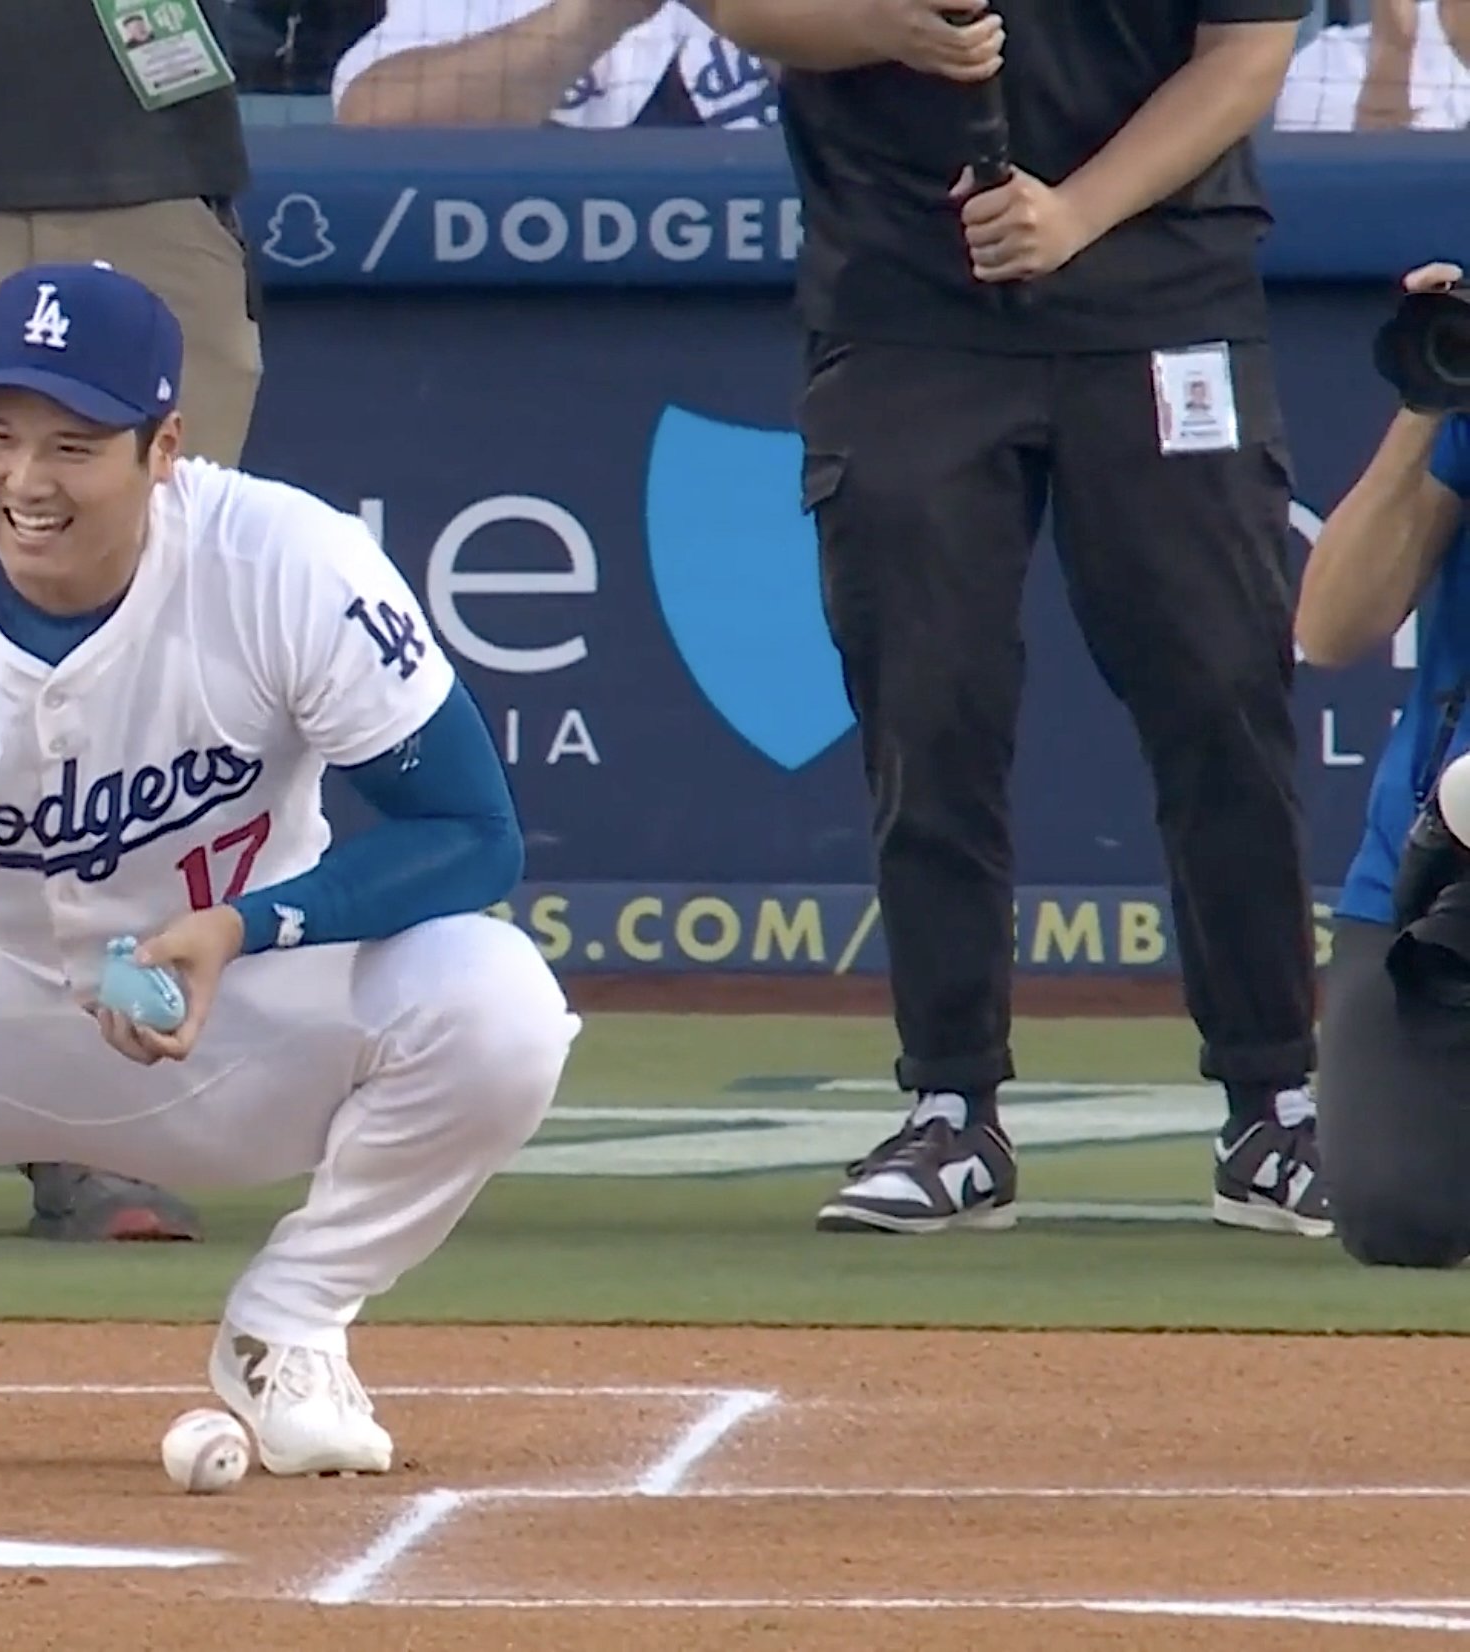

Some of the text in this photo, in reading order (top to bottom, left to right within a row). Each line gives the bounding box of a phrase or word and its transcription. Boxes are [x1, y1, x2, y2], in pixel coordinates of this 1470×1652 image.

[24, 283, 70, 348] LA
[346, 596, 425, 680] LA
[175, 810, 270, 911] 17
